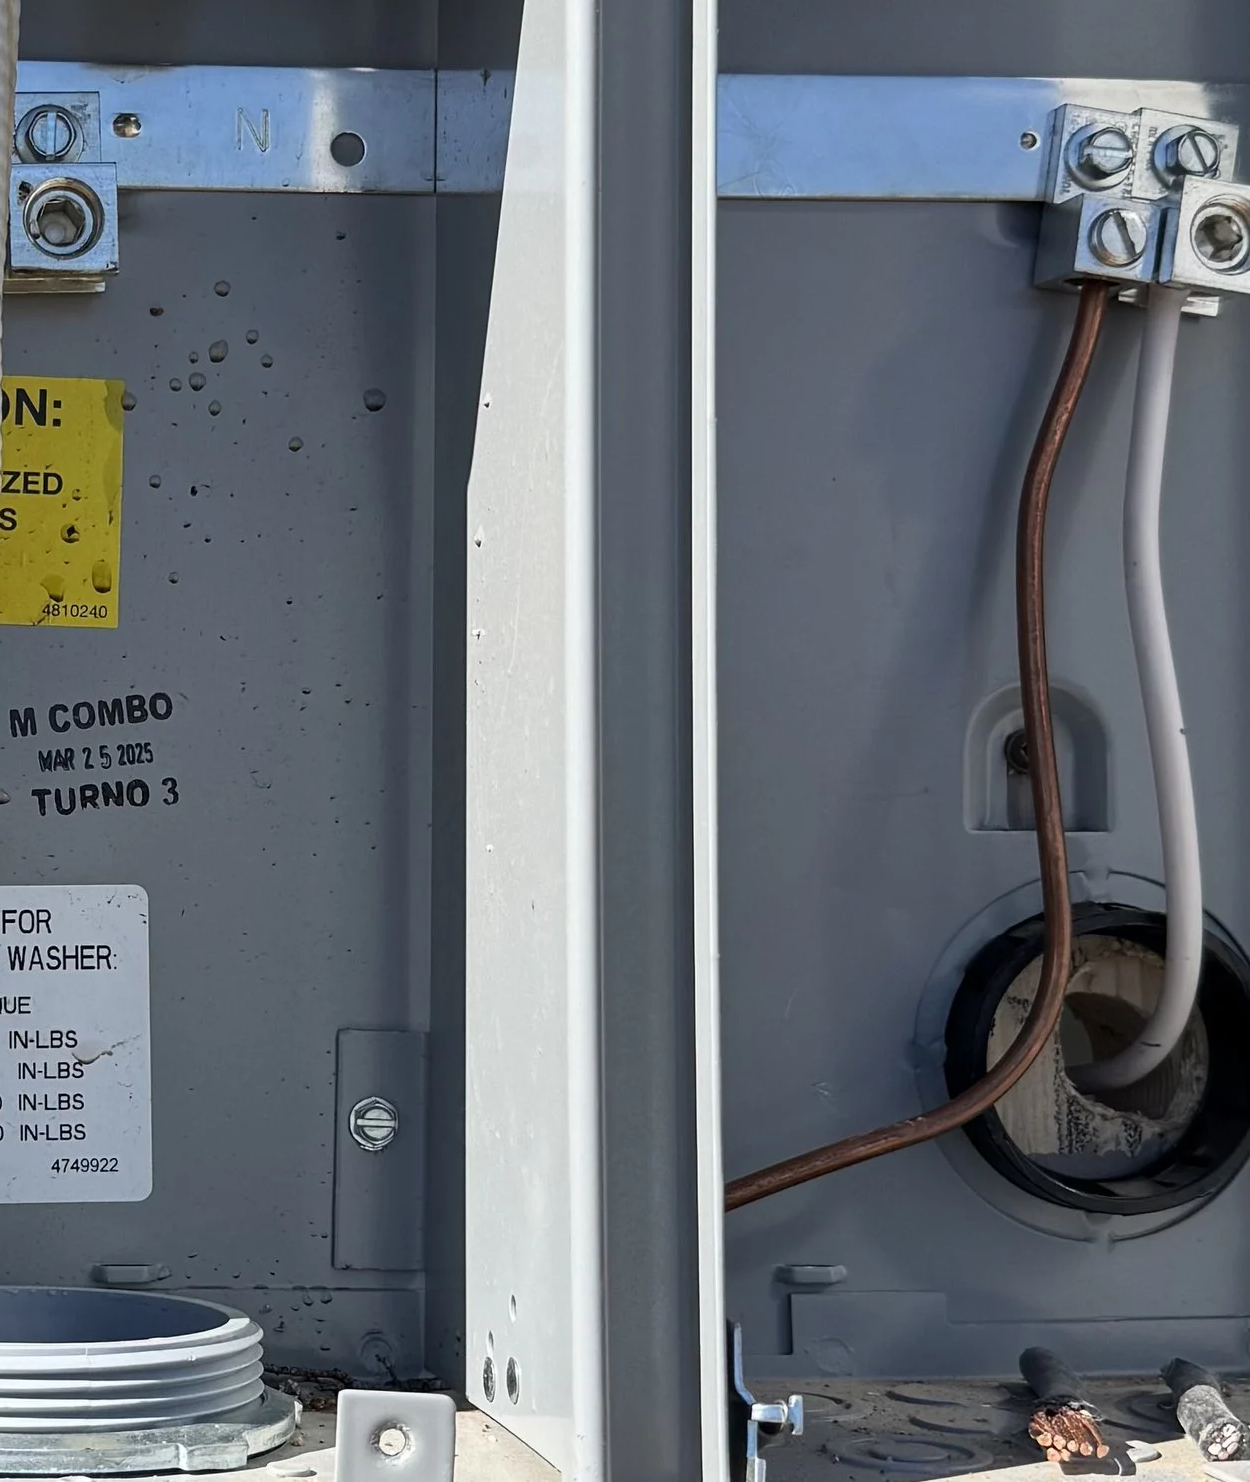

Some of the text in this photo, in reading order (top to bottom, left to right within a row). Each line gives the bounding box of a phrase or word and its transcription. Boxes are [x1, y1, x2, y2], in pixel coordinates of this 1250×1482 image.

[236, 107, 270, 153] N
[42, 604, 108, 619] 4810240
[9, 692, 173, 737] M COMBO
[38, 747, 76, 772] MAR
[117, 742, 154, 766] 2025
[31, 777, 180, 816] TURNO 3
[2, 909, 52, 934] FOR
[7, 945, 117, 970] WASHER:
[8, 1030, 78, 1049] IN-LBS
[18, 1062, 84, 1080] IN-LBS
[18, 1093, 85, 1111] IN-LBS
[20, 1124, 86, 1141] IN-LBS
[51, 1157, 119, 1174] 4749922
